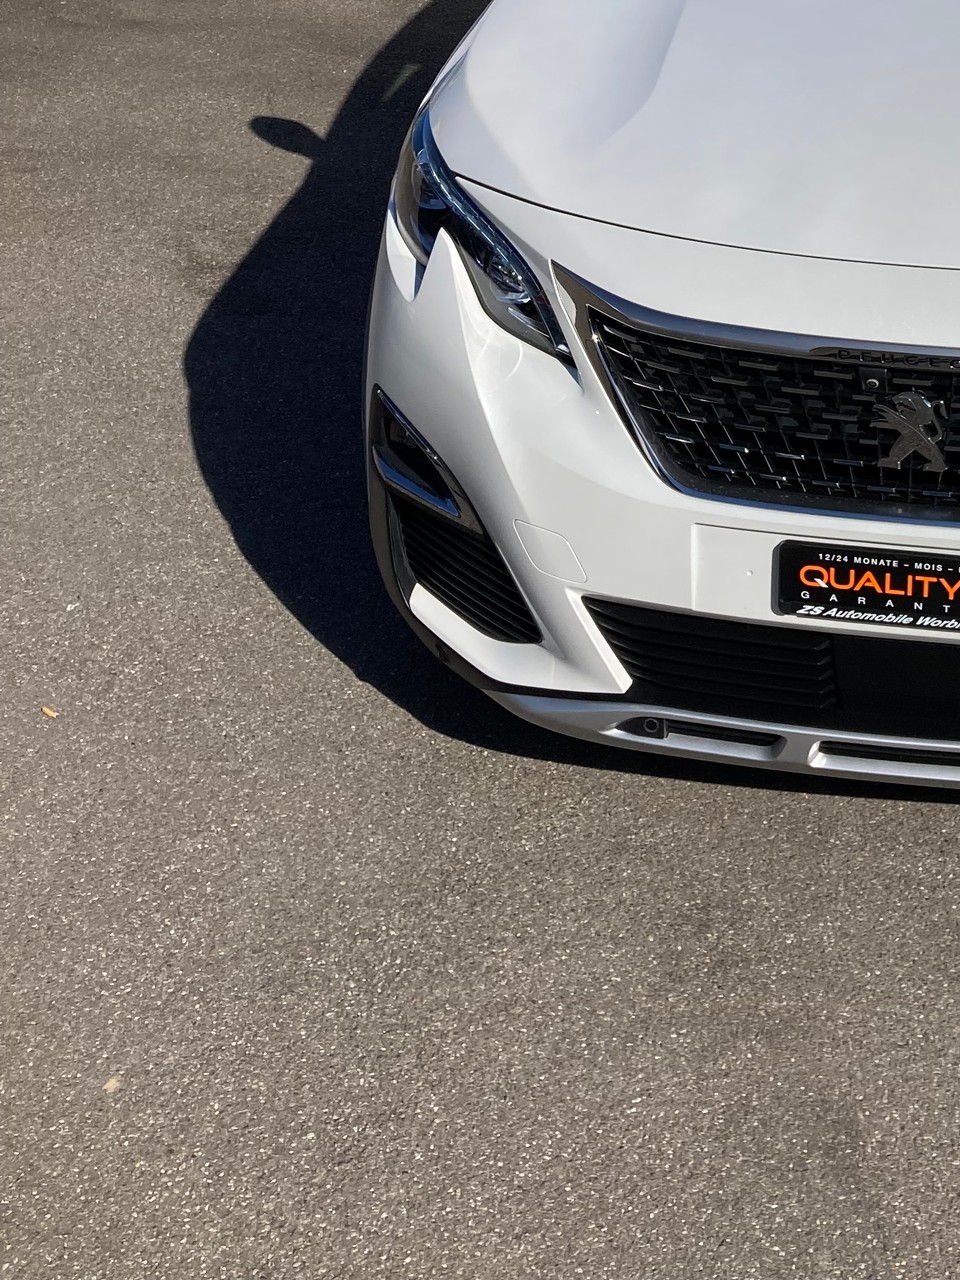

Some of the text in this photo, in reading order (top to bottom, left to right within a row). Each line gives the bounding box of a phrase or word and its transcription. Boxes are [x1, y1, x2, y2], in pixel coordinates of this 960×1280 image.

[818, 553, 849, 564] 12/24
[853, 556, 899, 568] MONATE
[914, 562, 943, 572] MOIS
[796, 604, 824, 615] ZS
[823, 607, 914, 625] Automobile
